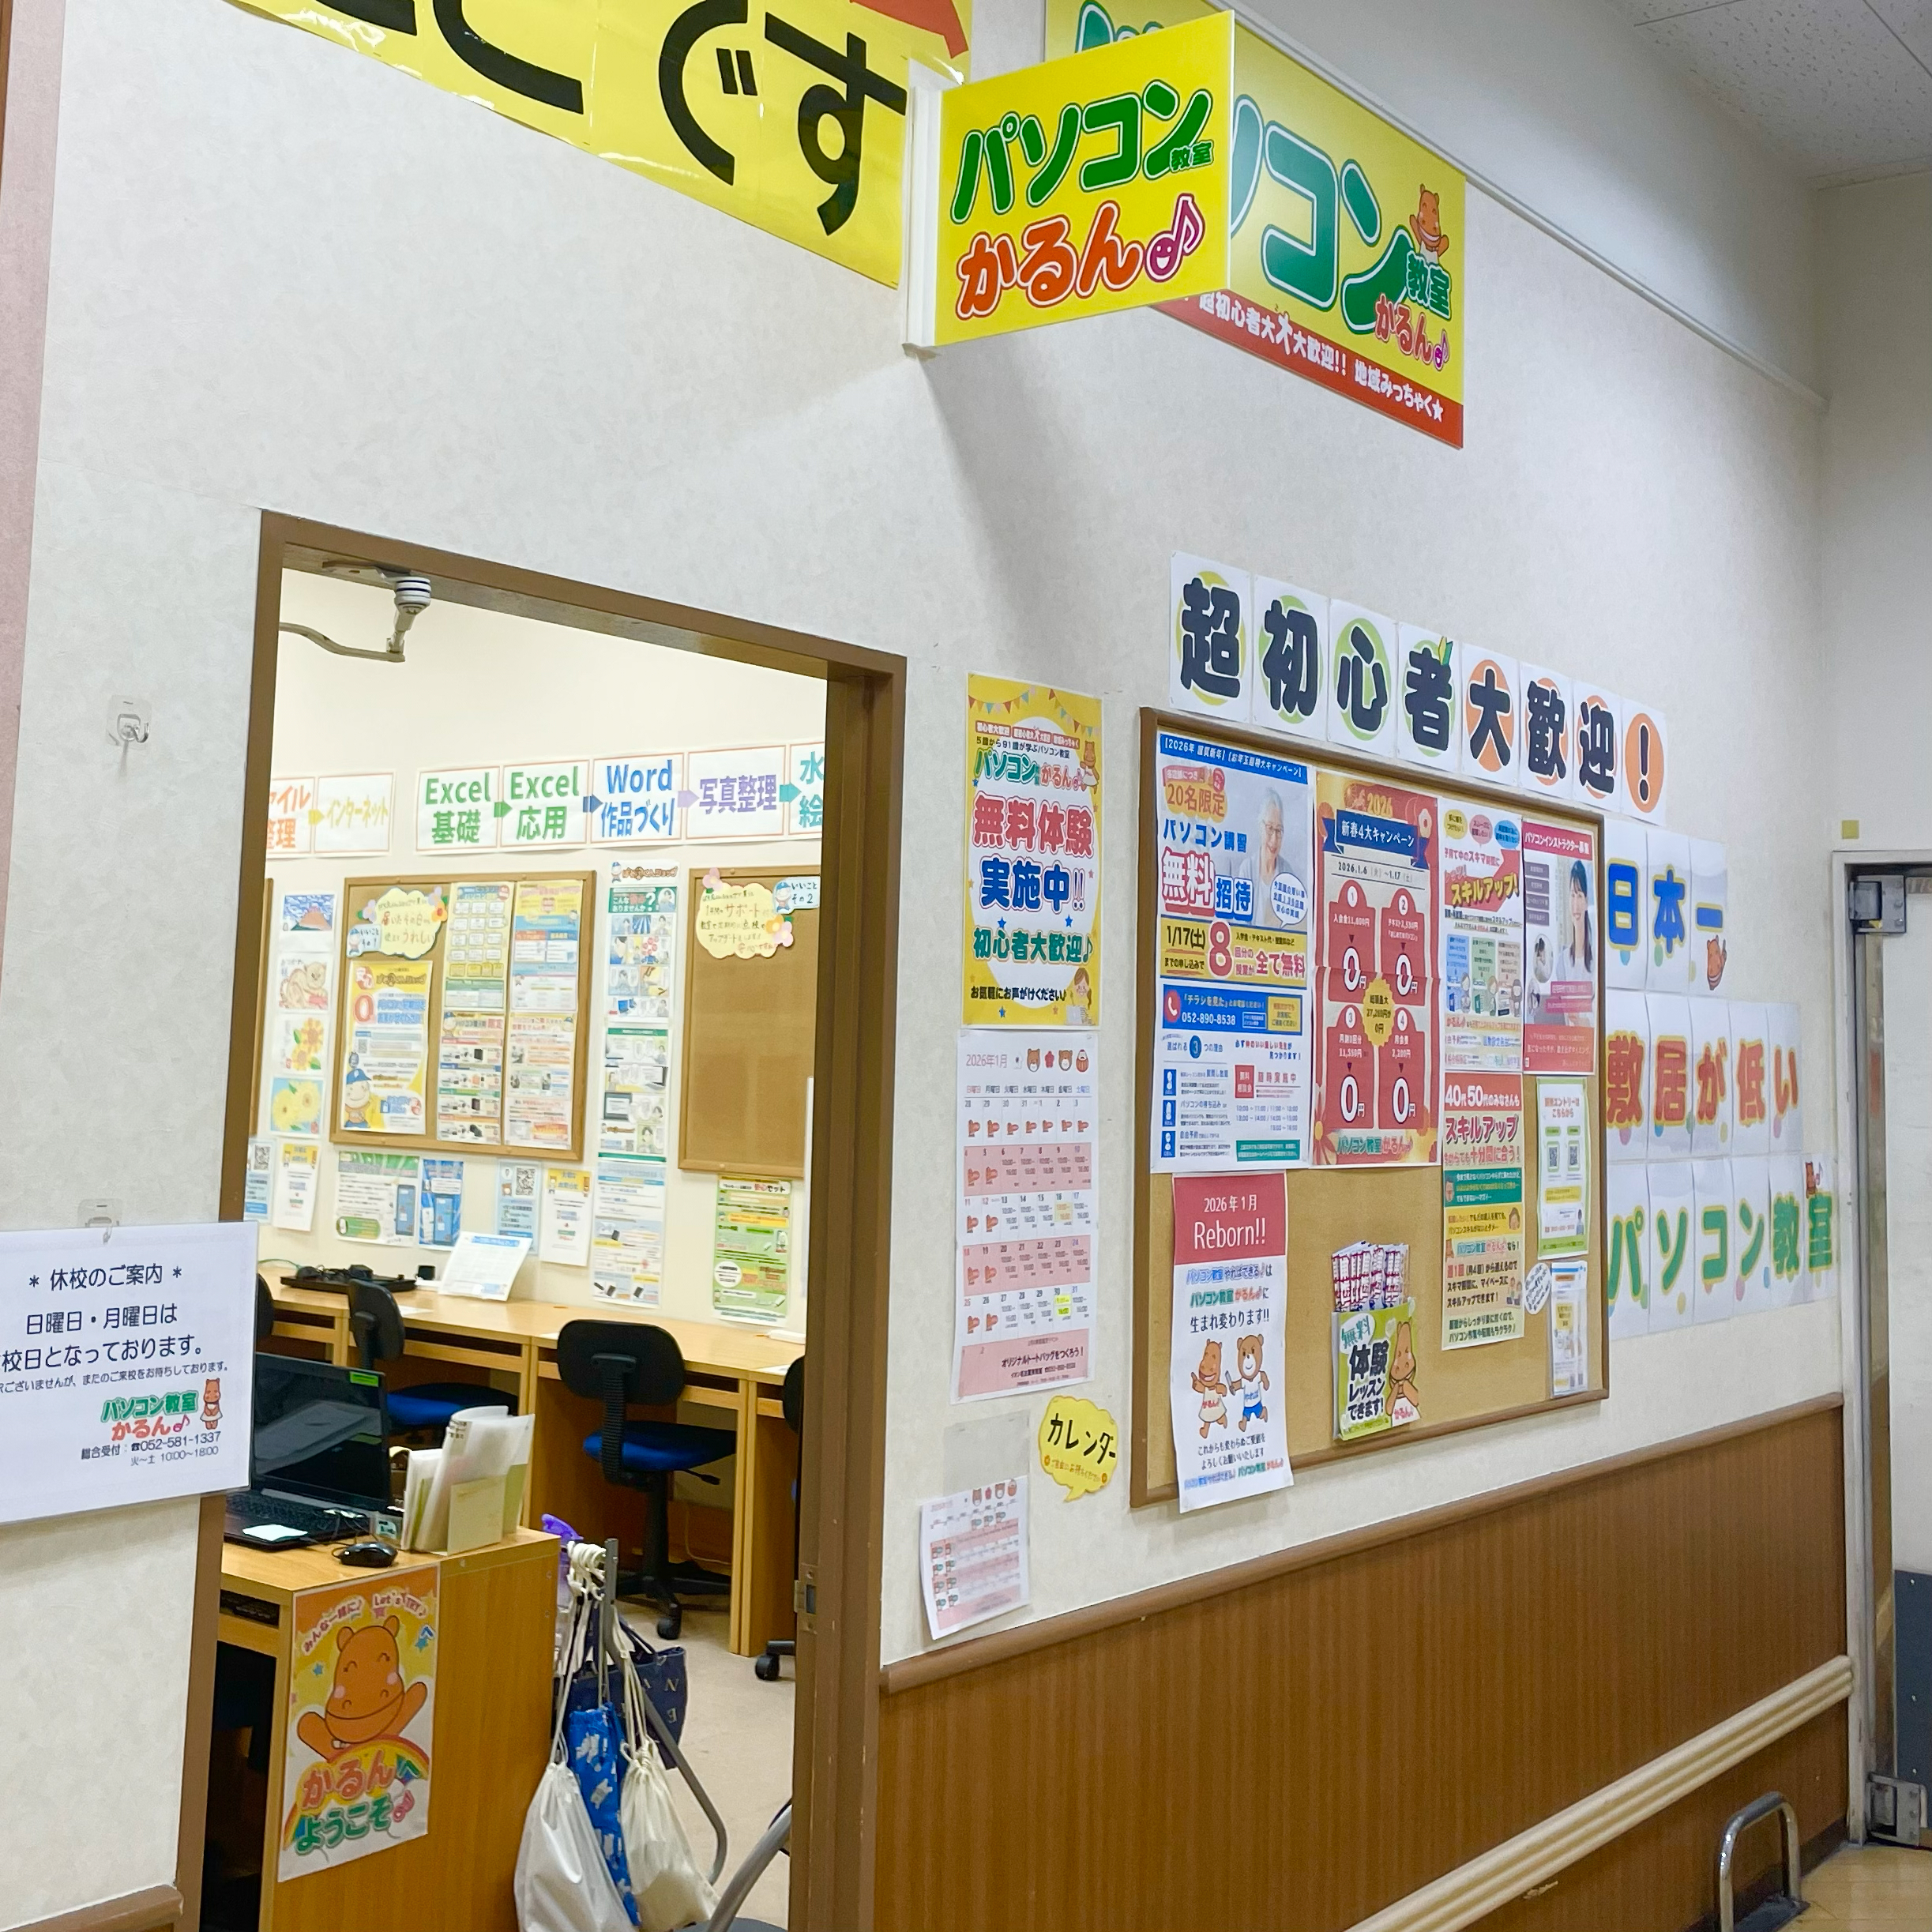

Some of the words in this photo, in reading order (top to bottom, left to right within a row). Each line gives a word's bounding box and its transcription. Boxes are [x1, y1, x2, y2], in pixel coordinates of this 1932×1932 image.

[950, 80, 1212, 224] パソコン
[1169, 141, 1214, 171] 教室
[957, 200, 1143, 320] かるん
[1405, 252, 1452, 319] 教室
[1375, 294, 1434, 365] かるん
[510, 765, 579, 799] Excel
[607, 759, 673, 794] Word
[975, 748, 1038, 784] パソコン
[1040, 763, 1072, 790] かるん
[425, 772, 491, 805] Excel
[699, 774, 777, 814] 写真整理
[1167, 784, 1225, 817] 20名限定
[1367, 792, 1393, 818] 2026
[325, 795, 389, 830] インターネット
[431, 809, 481, 844] 基礎
[516, 806, 567, 840] 応用
[600, 798, 675, 838] 作品づくり
[973, 792, 1094, 856] 無料体験
[1163, 818, 1247, 853] パソコン講習
[1341, 820, 1415, 847] 新春4大キャンペーン
[791, 881, 818, 891] いいこと
[979, 857, 1084, 913] 実施中!!
[1163, 848, 1214, 908] 無料
[1216, 877, 1251, 911] 招待
[1452, 873, 1519, 908] スキルアップ!
[1608, 863, 1723, 954] 日本一
[1167, 925, 1205, 949] 1/17(土)
[1209, 923, 1232, 976] 8
[1256, 950, 1305, 978] 全て無料
[1182, 1012, 1236, 1025] 052-890-8538
[966, 1054, 1008, 1068] 2026年1月
[1607, 1036, 1799, 1125] 敷居が低い
[1445, 1114, 1518, 1144] スキルアップ
[1194, 1217, 1266, 1250] Reborn!!
[1607, 1193, 1832, 1300] パソコン教室
[50, 1264, 164, 1291] 休校のご案内
[27, 1303, 179, 1335] 日曜日・月曜日は
[1190, 1308, 1269, 1333] 生まれ変わります!!
[1341, 1315, 1370, 1349] 無料
[0, 1333, 202, 1373] 校日となっております。
[1349, 1340, 1389, 1380] 体験
[103, 1392, 197, 1422] パソコン教室
[1349, 1379, 1385, 1403] レッスン
[112, 1416, 171, 1441] かるん
[140, 1431, 221, 1452] 052-581-1337
[1047, 1412, 1116, 1464] カレンダー
[295, 1793, 395, 1855] ようこそ
